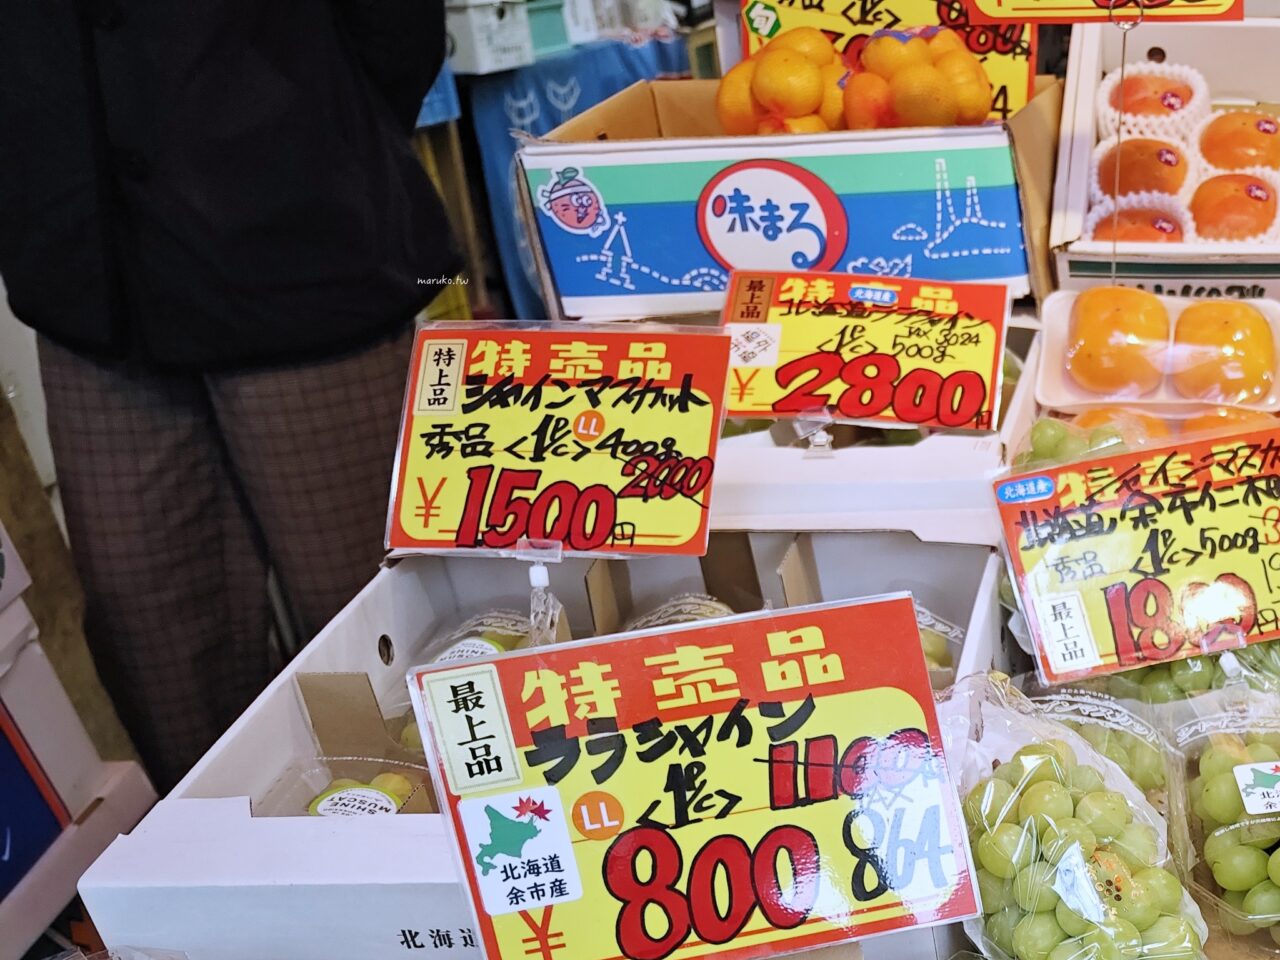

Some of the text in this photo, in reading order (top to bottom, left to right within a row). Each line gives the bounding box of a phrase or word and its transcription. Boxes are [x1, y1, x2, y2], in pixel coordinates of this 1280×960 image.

[713, 188, 825, 269] 味まる
[740, 280, 766, 319] 最上品
[935, 329, 981, 347] 3024
[427, 346, 457, 407] 特上品
[469, 340, 672, 381] 特売品
[461, 373, 710, 414] シャインマスカット
[420, 422, 495, 459] 秀品
[578, 415, 599, 436] LL
[1004, 482, 1049, 500] 北海道産
[1049, 601, 1086, 662] 最上品
[521, 625, 844, 726] 特売品
[447, 681, 503, 779] 最上品
[581, 803, 620, 830] LL
[501, 856, 564, 882] 北海道
[507, 881, 570, 907] 余市産
